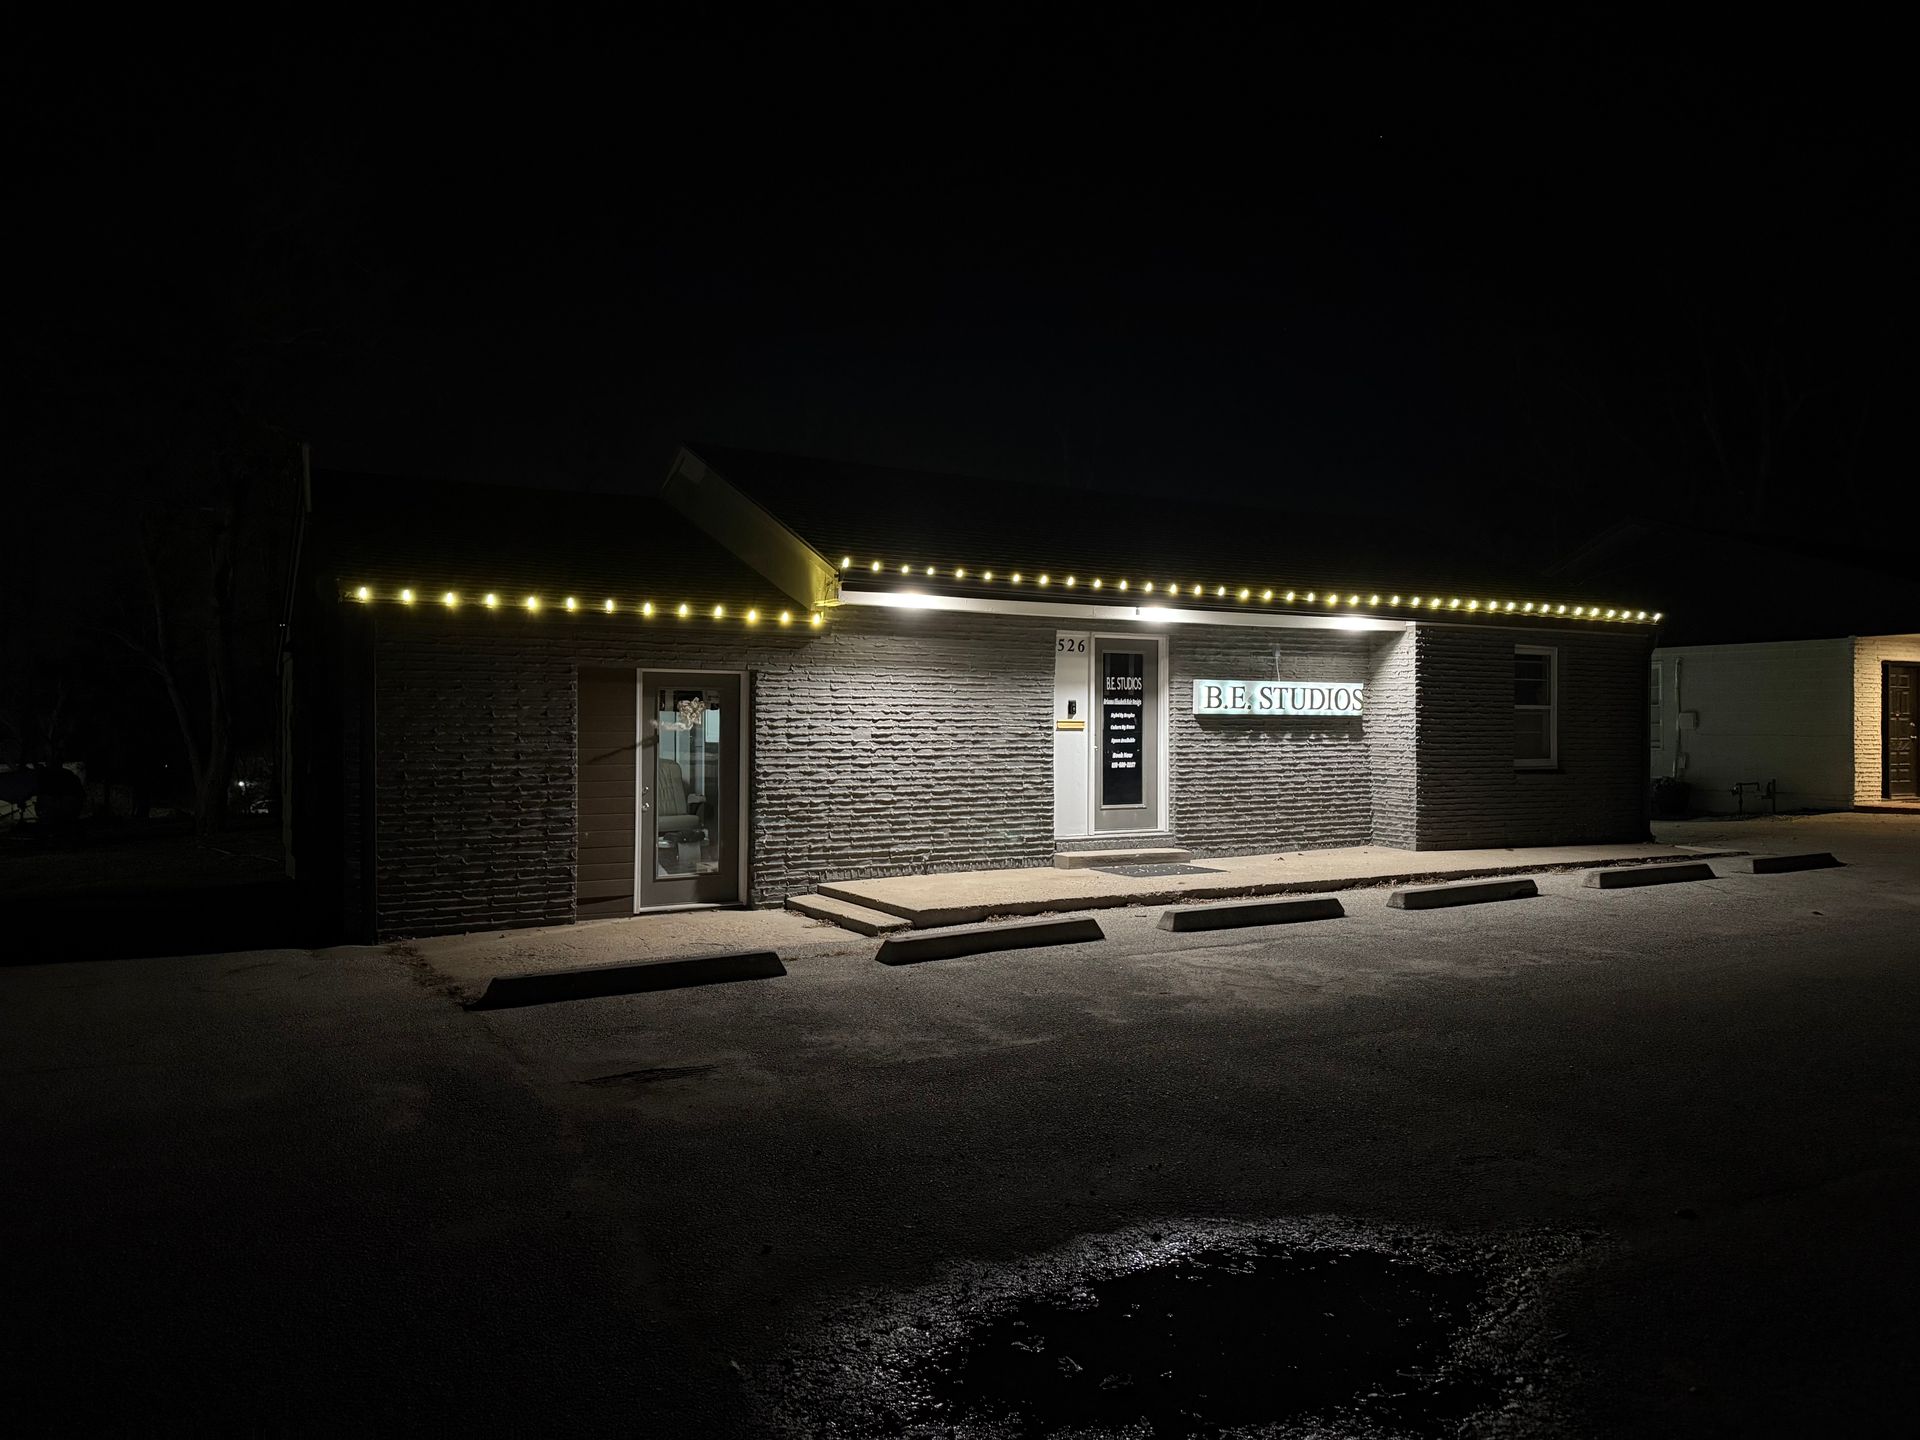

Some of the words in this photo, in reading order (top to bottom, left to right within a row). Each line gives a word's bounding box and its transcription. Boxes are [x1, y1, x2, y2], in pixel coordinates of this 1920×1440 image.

[1057, 639, 1085, 652] 526
[1117, 677, 1142, 690] STUDIOS
[1204, 686, 1251, 710] B.E.
[1259, 686, 1363, 711] STUDIOS
